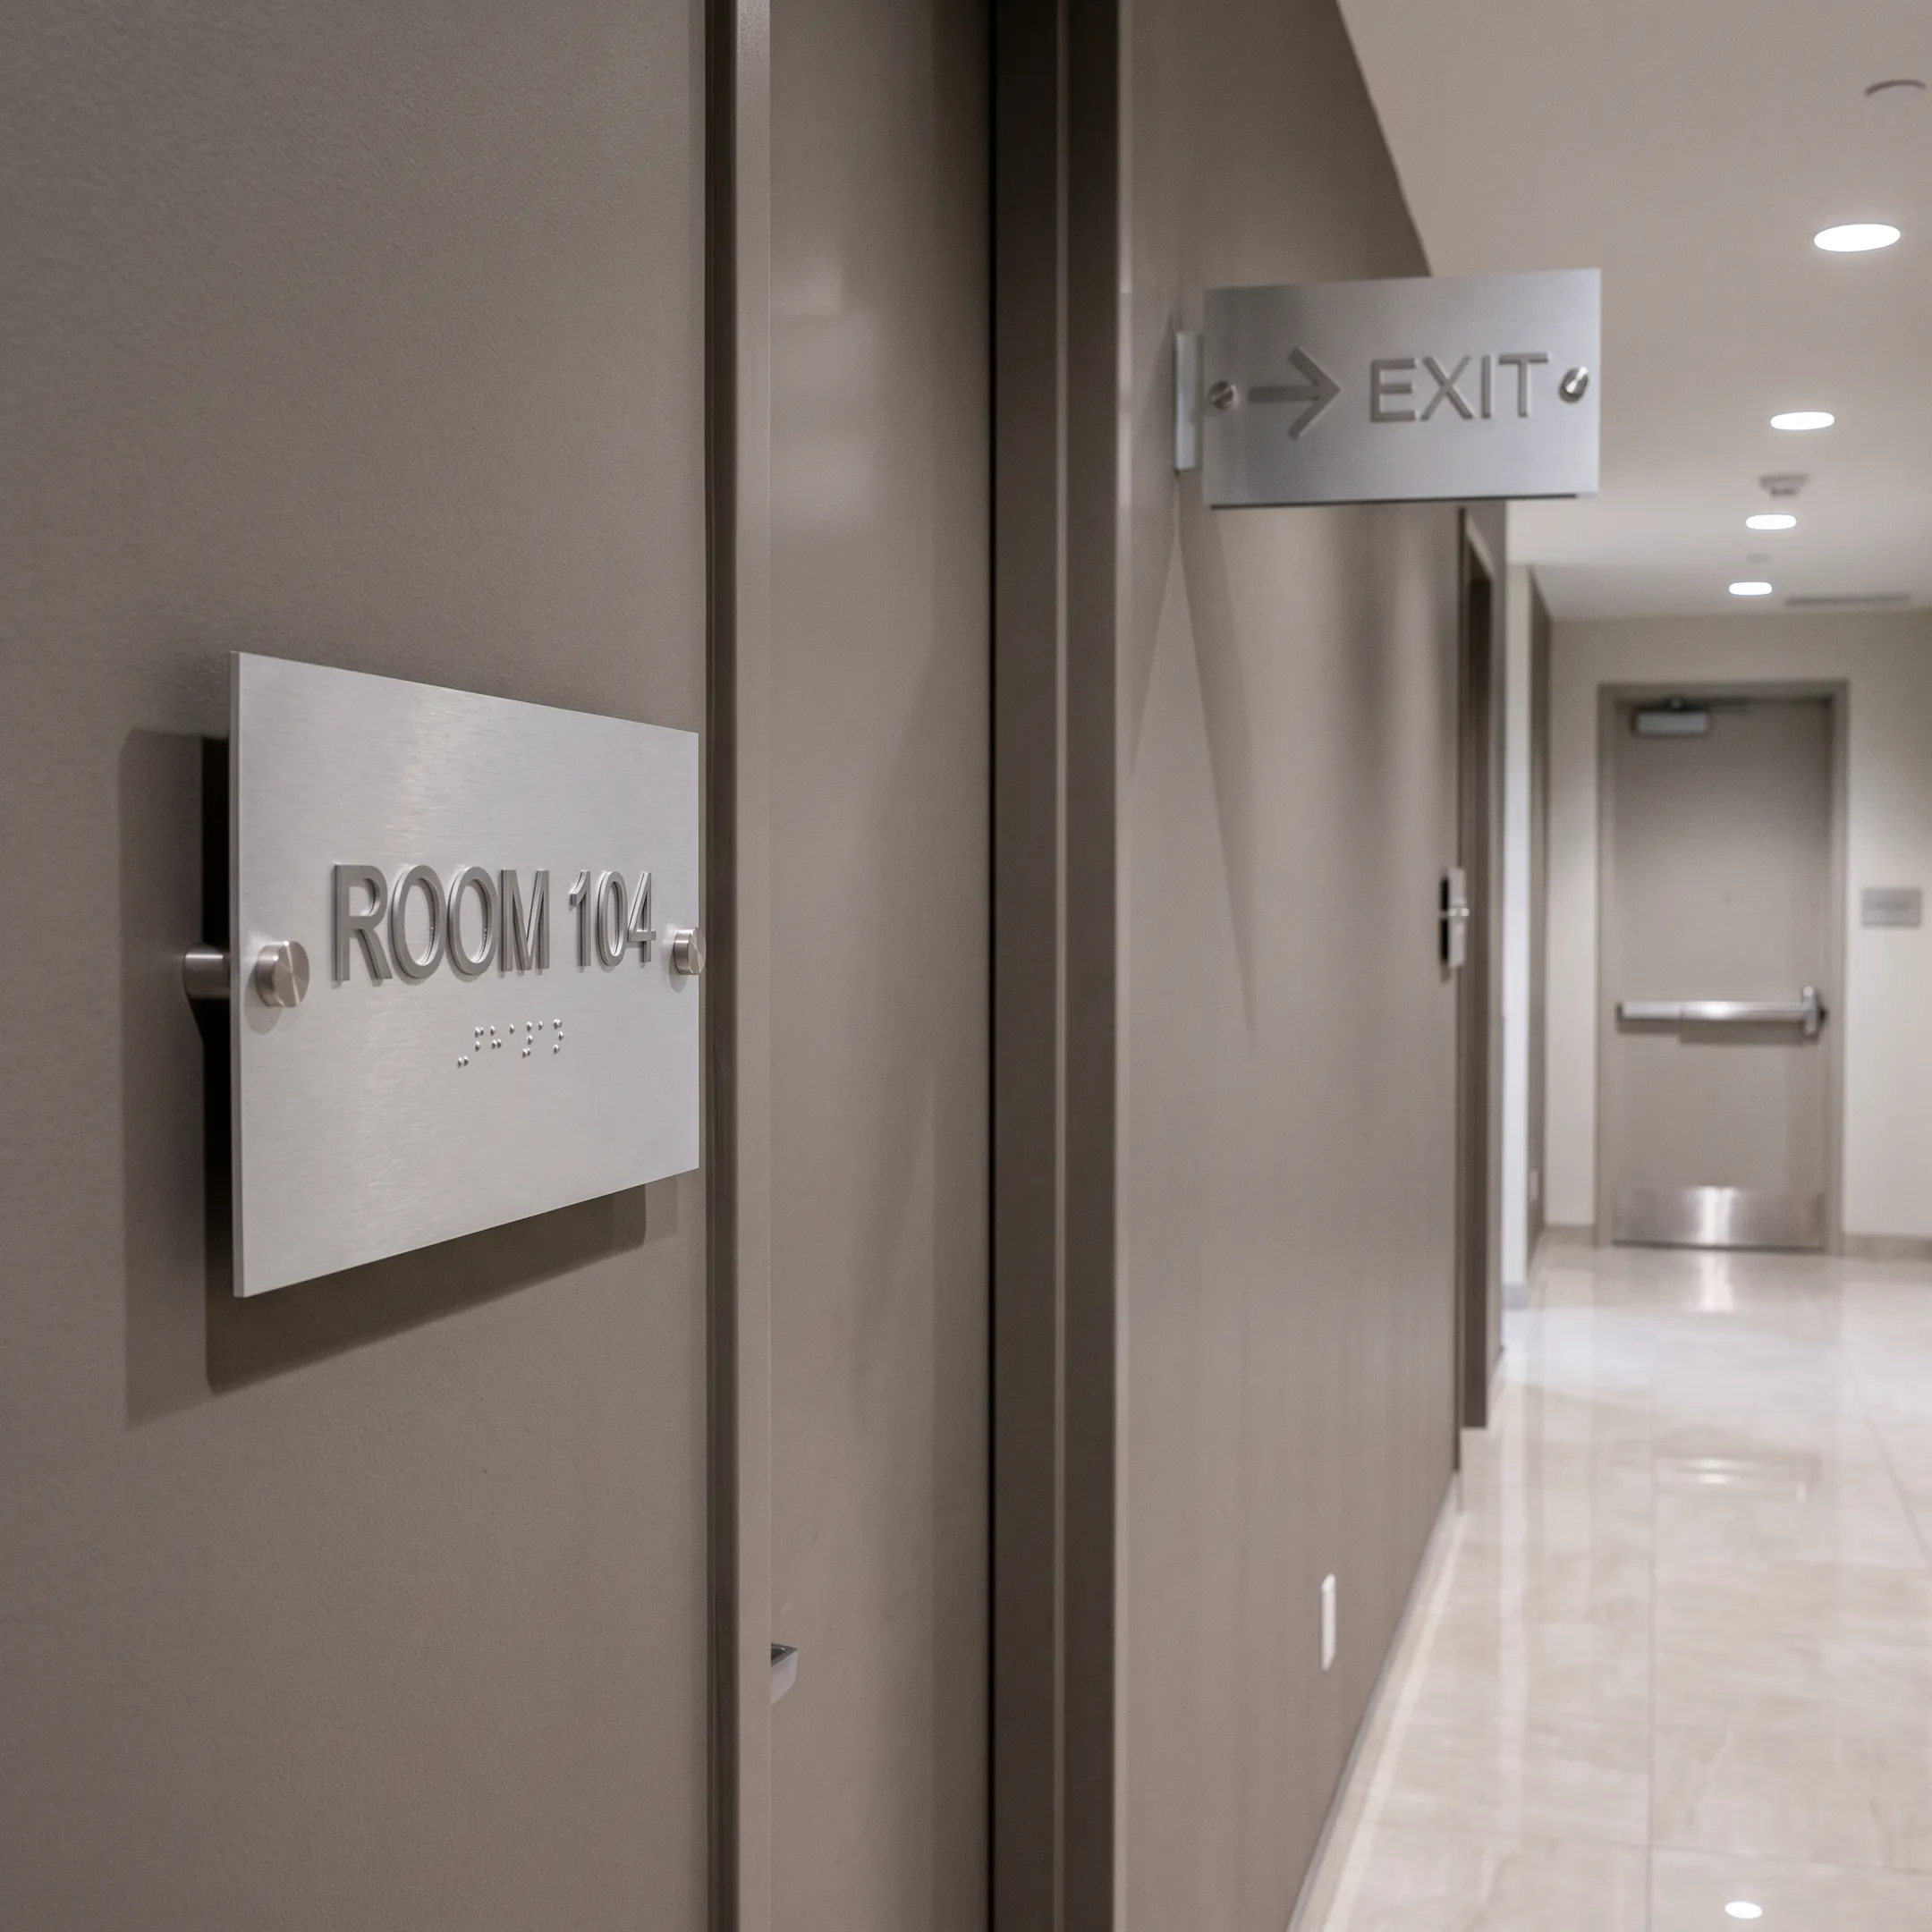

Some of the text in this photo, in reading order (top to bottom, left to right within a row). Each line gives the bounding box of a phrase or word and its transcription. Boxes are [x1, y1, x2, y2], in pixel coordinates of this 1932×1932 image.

[1370, 352, 1549, 423] EXIT
[333, 864, 657, 981] ROOM 104
